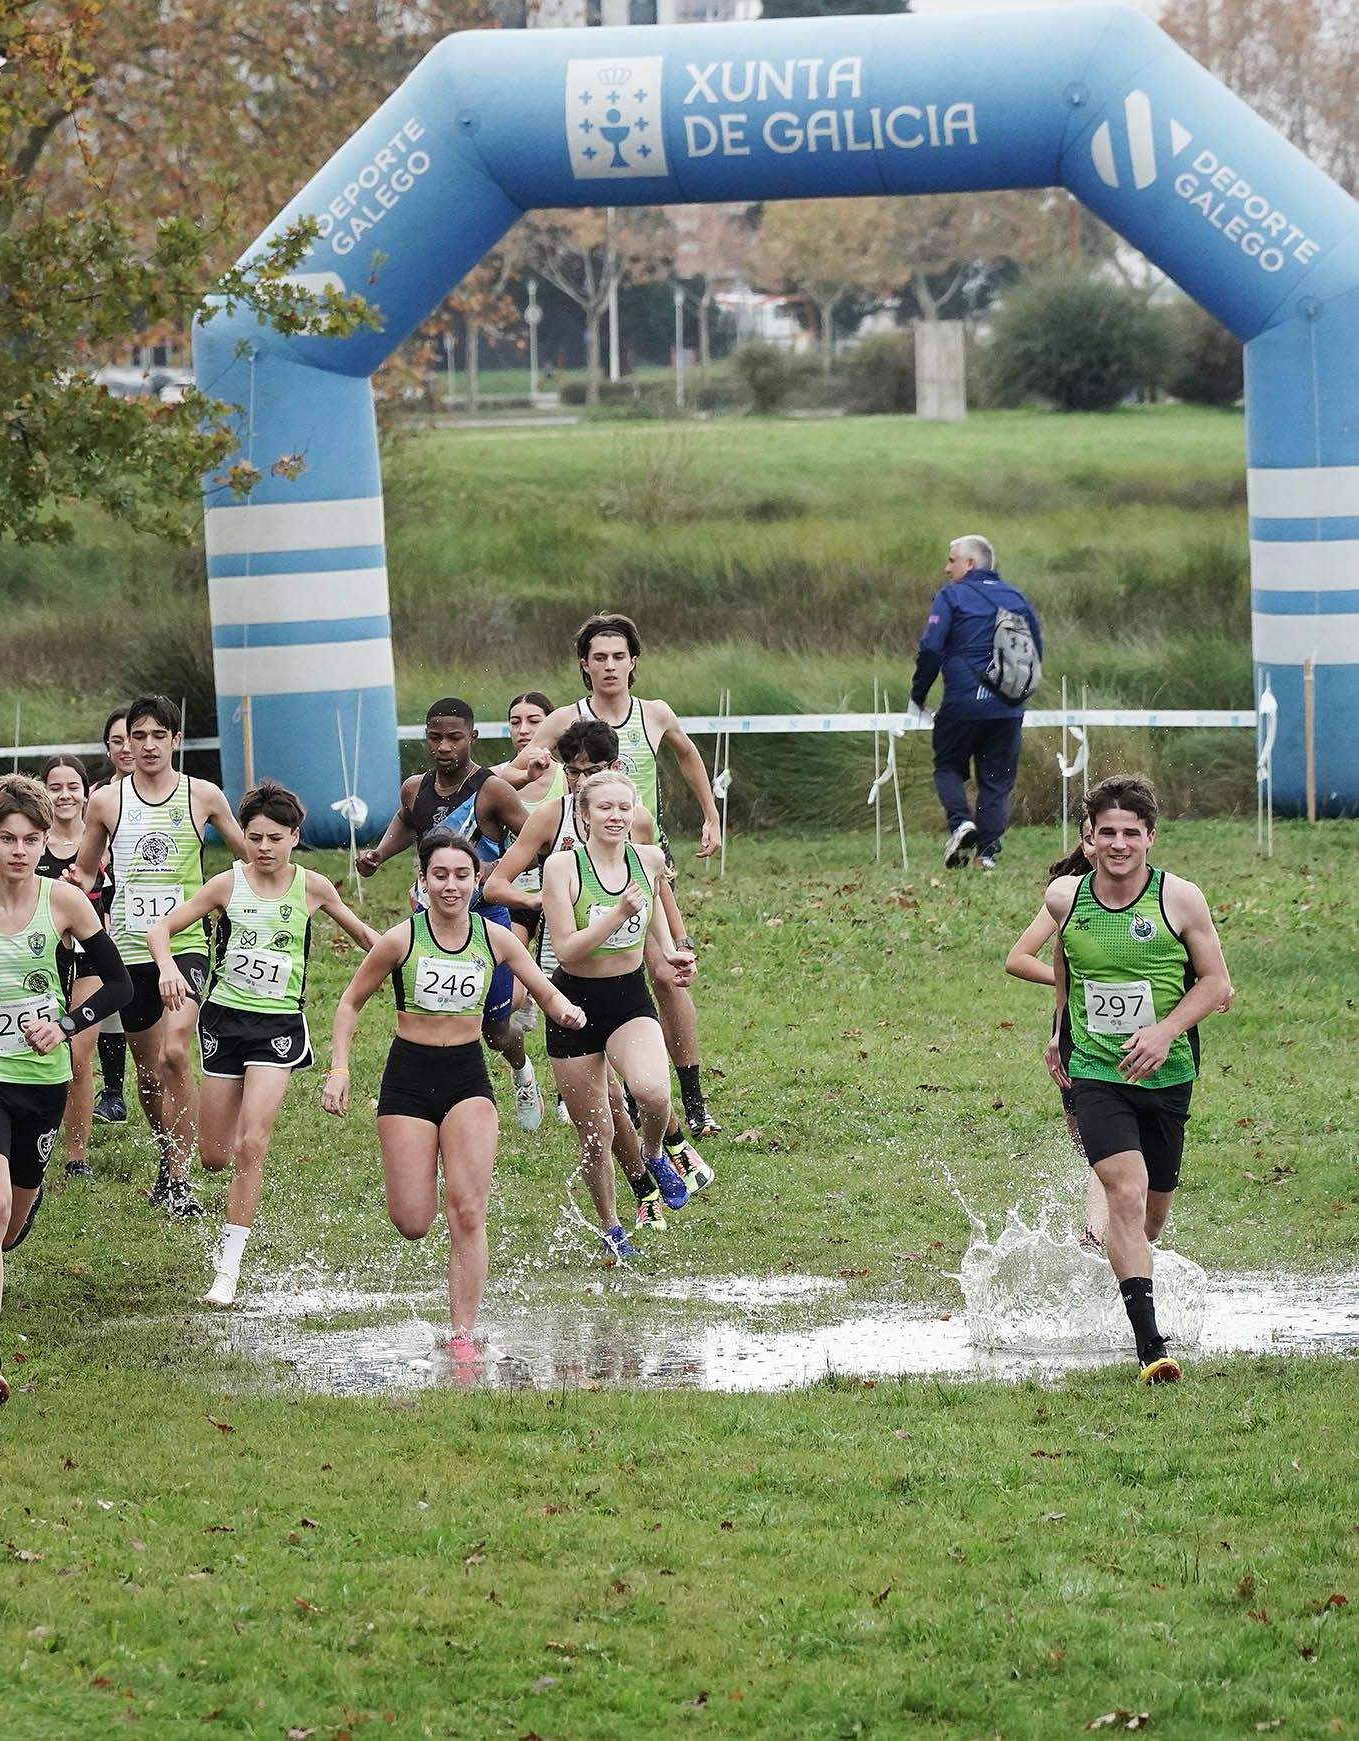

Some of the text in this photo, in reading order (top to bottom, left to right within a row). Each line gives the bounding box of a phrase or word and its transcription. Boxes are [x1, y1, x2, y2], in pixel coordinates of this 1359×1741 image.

[683, 57, 862, 104] XUNTA
[683, 102, 978, 158] DE GALICIA
[317, 117, 425, 238] DEPORTE
[331, 150, 430, 255] GALEGO
[1174, 173, 1284, 273] GALEGO
[1193, 149, 1321, 265] DEPORTE
[132, 896, 176, 917] 312
[233, 954, 279, 983] 251
[423, 971, 475, 997] 246
[1092, 994, 1144, 1017] 297
